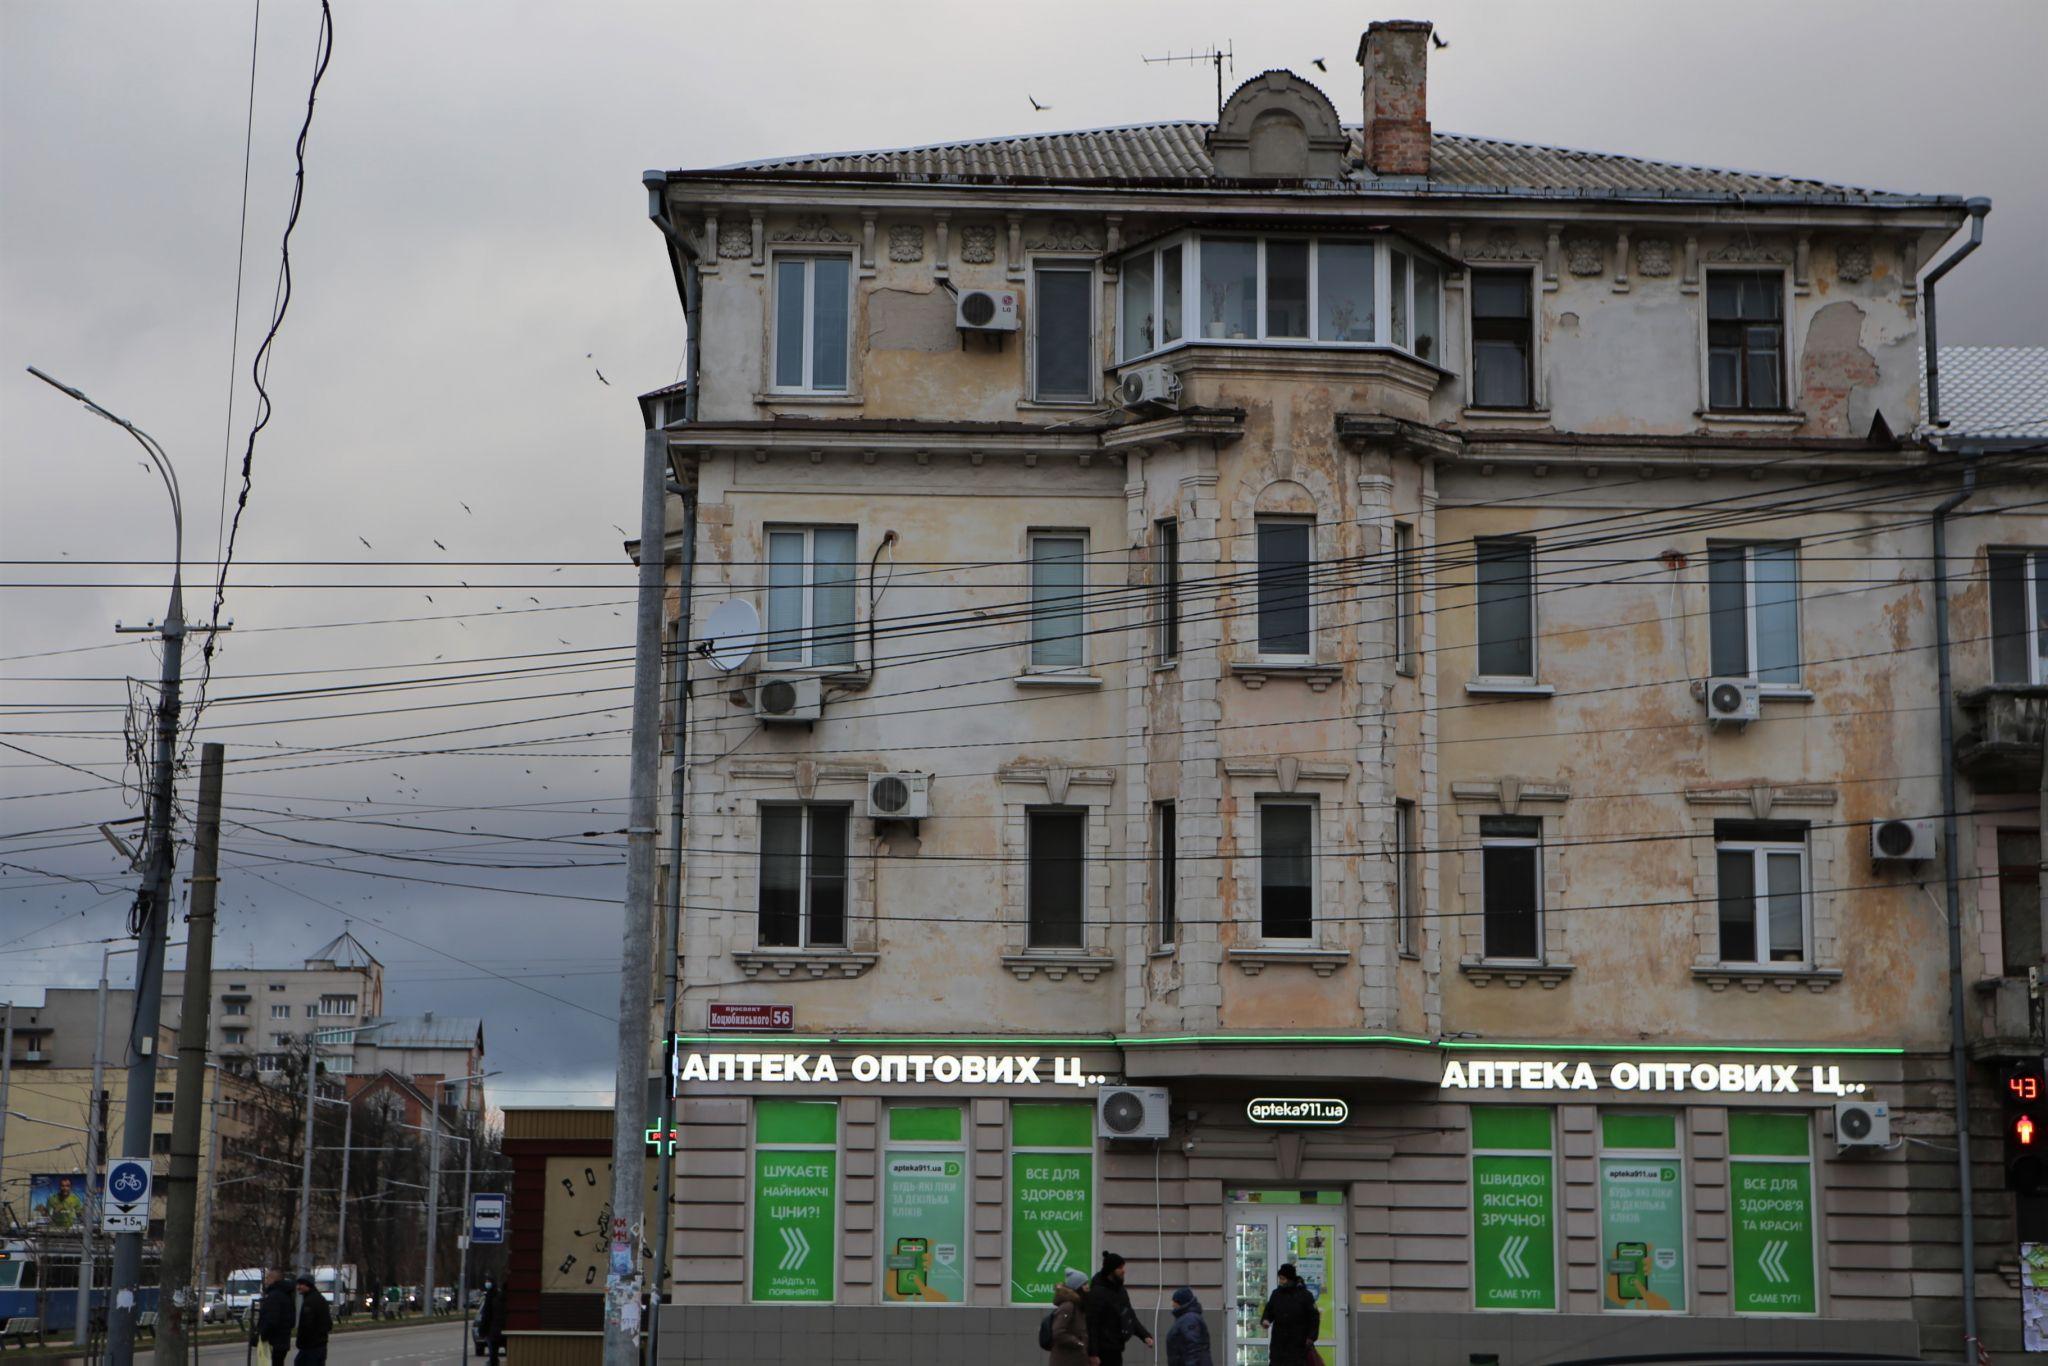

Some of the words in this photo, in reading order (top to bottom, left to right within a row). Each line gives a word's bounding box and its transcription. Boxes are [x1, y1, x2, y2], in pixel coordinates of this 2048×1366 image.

[711, 1012, 770, 1026] Коцюбинського
[773, 1010, 790, 1024] 56
[681, 1053, 838, 1082] АПТЕКА
[851, 1054, 1041, 1083] ОПТОВИХ
[1440, 1060, 1598, 1090] АПТЕКА
[1610, 1062, 1799, 1092] ОПТОВИХ
[2010, 1078, 2036, 1098] 43
[1252, 1101, 1343, 1119] apteka911.ua
[764, 1165, 829, 1178] ШУКАЄТЕ
[893, 1164, 942, 1173] apteka911.ua
[1026, 1168, 1049, 1180] ВСЕ
[1052, 1168, 1080, 1181] ДЛЯ
[1609, 1170, 1658, 1178] apteka911.ua
[1480, 1174, 1545, 1187] ШВИДКО!
[1743, 1178, 1767, 1190] ВСЕ
[1769, 1178, 1798, 1192] ДЛЯ
[763, 1184, 829, 1197] НАЙНИЖЧІ
[1483, 1193, 1543, 1207] ЯКІСНО!
[771, 1206, 820, 1220] ЦІНИ?!
[1023, 1210, 1037, 1221] ТА
[1041, 1209, 1083, 1221] КРАСИ!
[1481, 1213, 1546, 1227] ЗРУЧНО!
[1743, 1220, 1757, 1230] ТА
[1760, 1220, 1803, 1231] КРАСИ!
[806, 1278, 816, 1286] ТА
[1488, 1288, 1519, 1299] САМЕ
[1520, 1288, 1541, 1299] ТУТ!
[1748, 1293, 1779, 1303] САМЕ
[1780, 1293, 1801, 1304] ТУТ!
